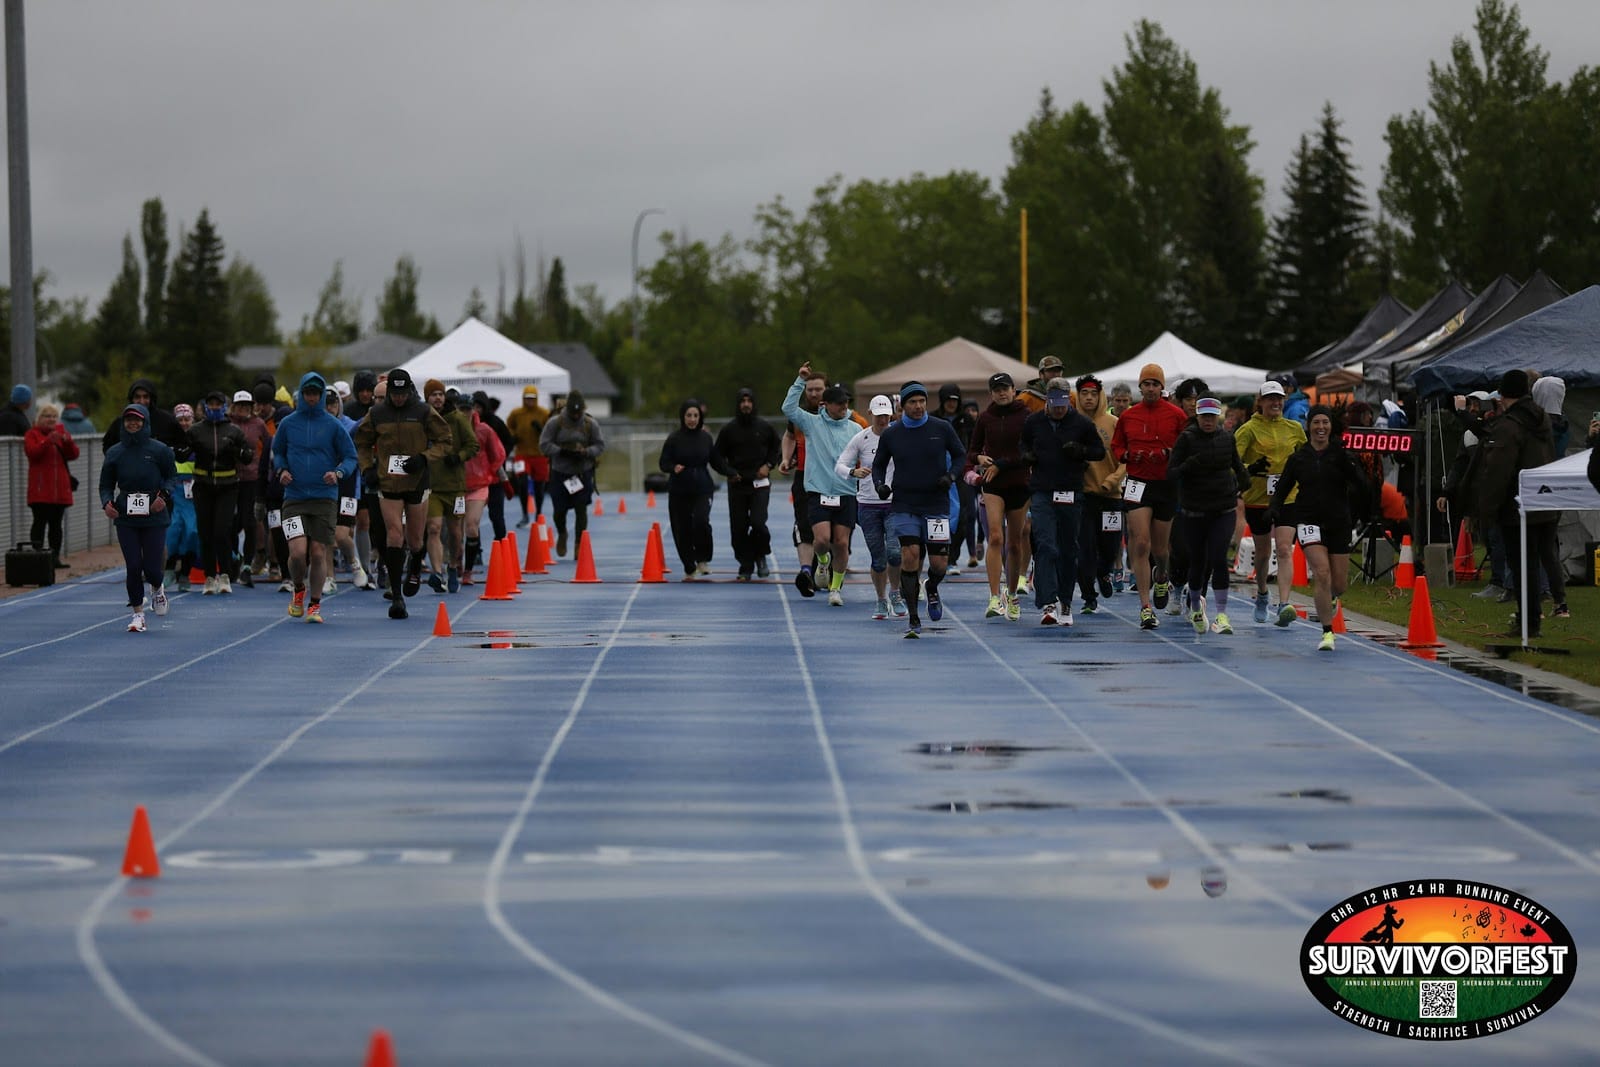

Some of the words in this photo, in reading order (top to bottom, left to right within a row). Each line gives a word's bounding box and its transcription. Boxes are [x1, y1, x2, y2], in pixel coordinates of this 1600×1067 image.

[1130, 485, 1138, 494] 3
[132, 498, 144, 507] 46
[1107, 516, 1118, 525] 72
[286, 522, 298, 532] 76
[932, 523, 944, 533] 71
[1302, 526, 1315, 536] 18
